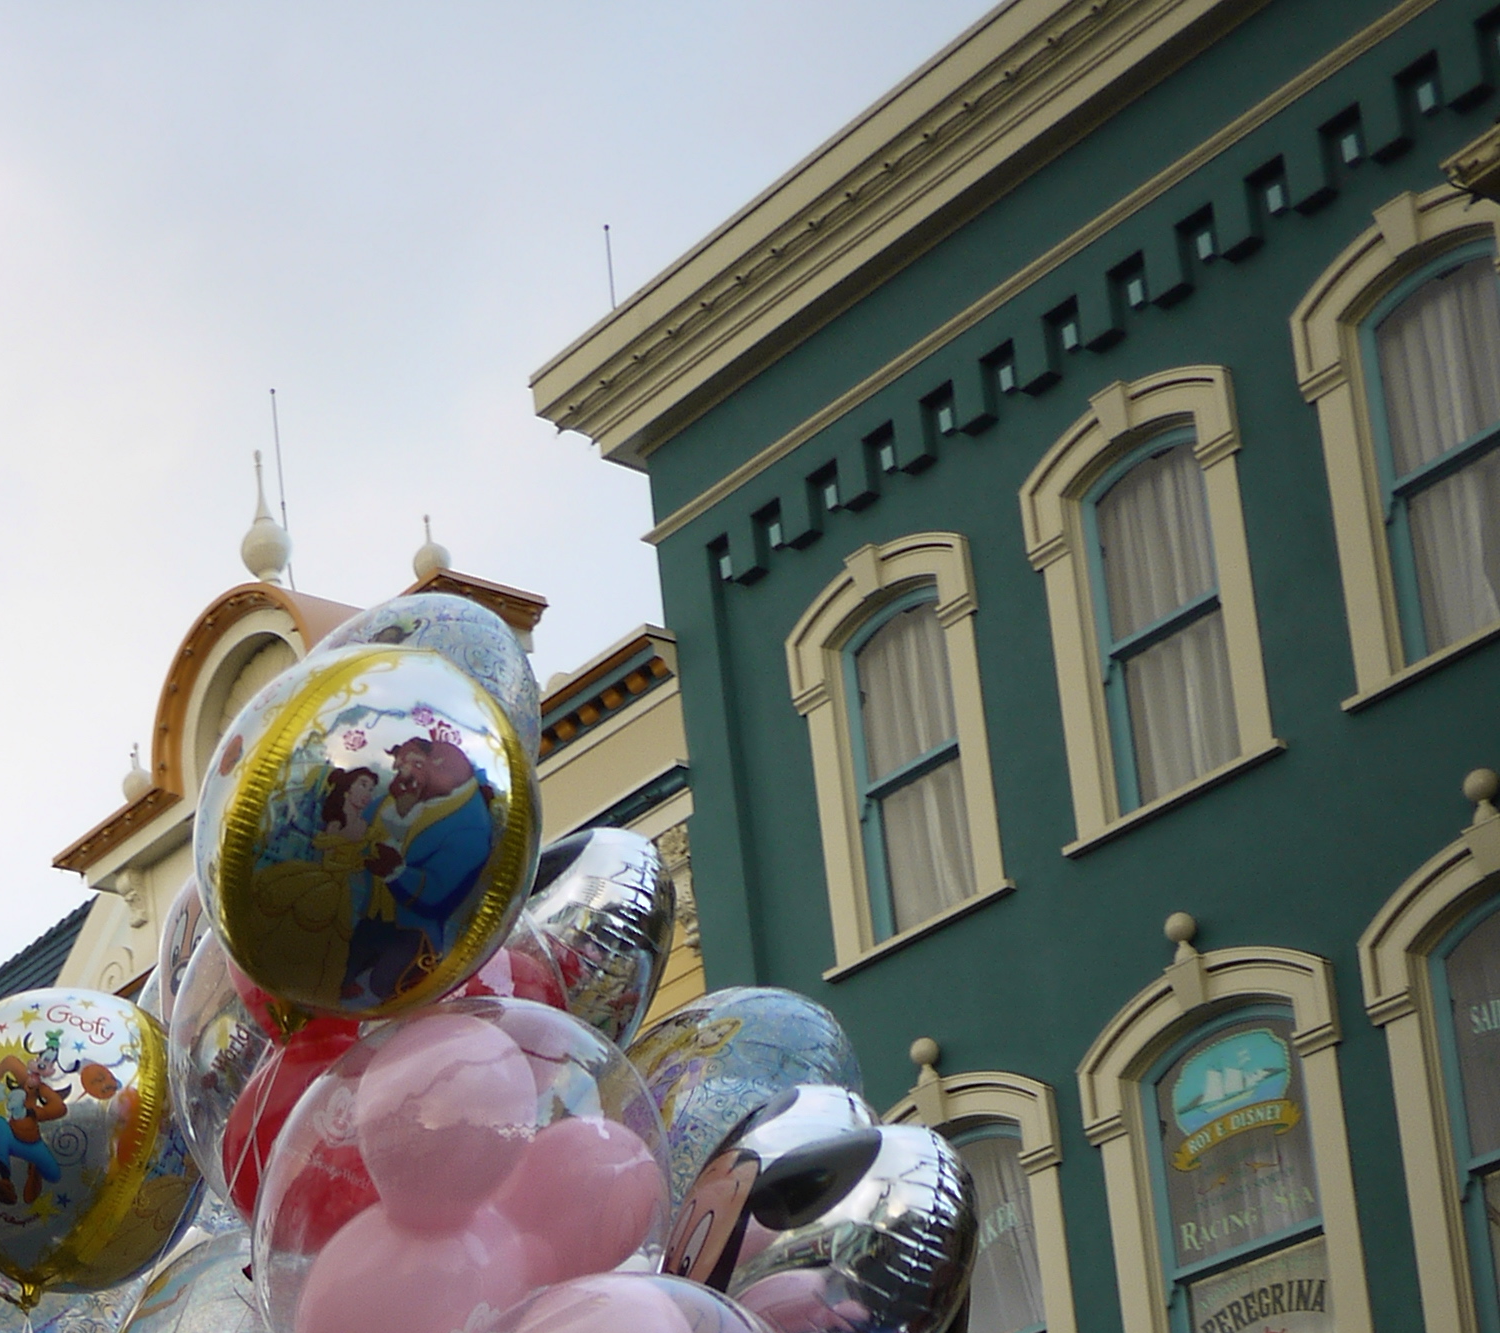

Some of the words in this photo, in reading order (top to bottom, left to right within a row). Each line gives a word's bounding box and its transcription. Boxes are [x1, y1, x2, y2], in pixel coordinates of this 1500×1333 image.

[46, 1003, 115, 1045] Goofy
[211, 1023, 251, 1073] World
[1186, 1131, 1213, 1155] ROY
[1230, 1103, 1283, 1132] DISNEY
